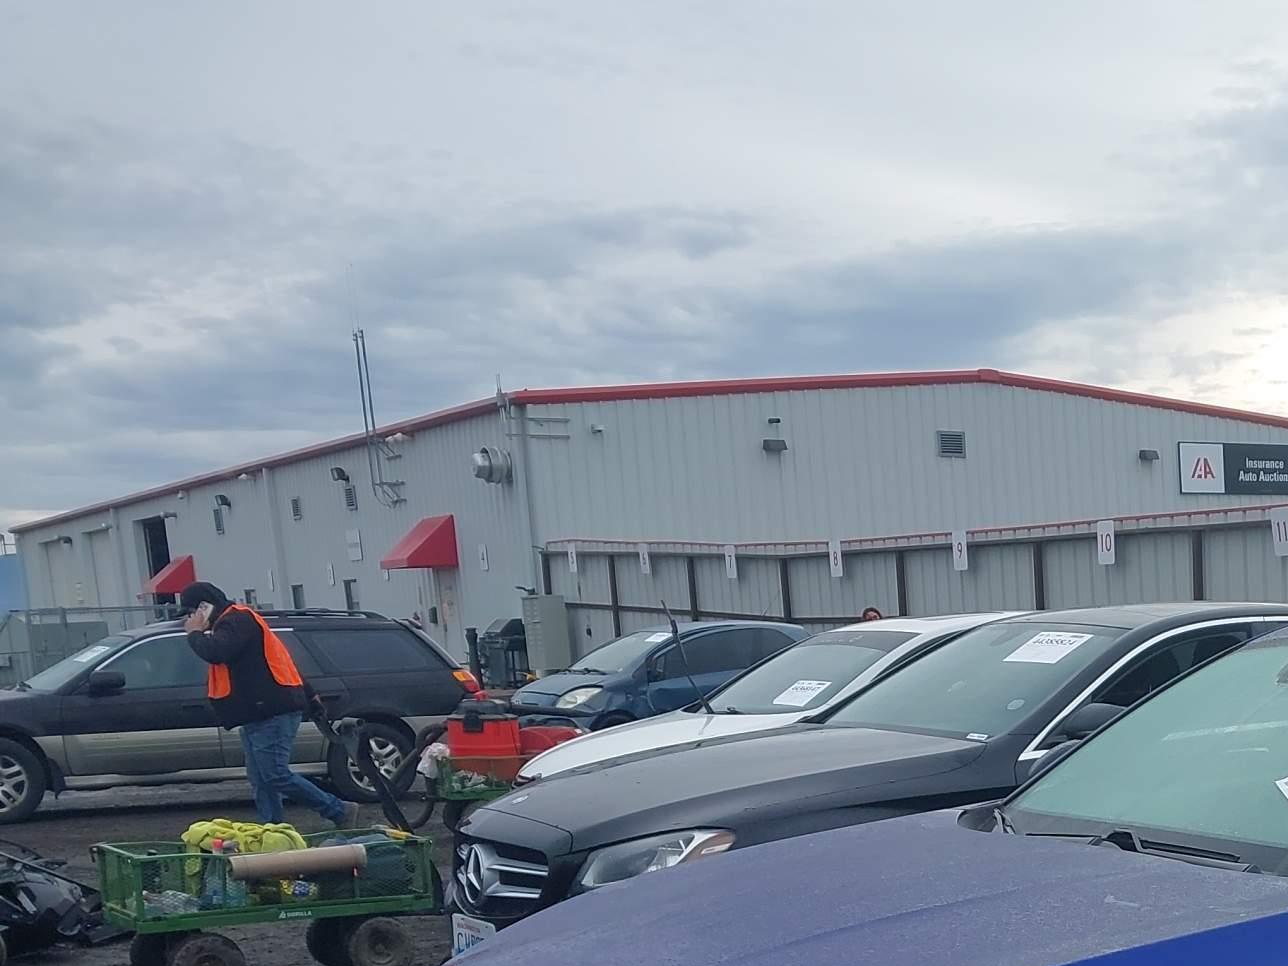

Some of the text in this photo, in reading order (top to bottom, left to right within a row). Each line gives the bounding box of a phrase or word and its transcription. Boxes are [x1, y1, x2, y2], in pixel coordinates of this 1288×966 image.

[1245, 457, 1285, 470] Insurance
[1238, 470, 1258, 482] Auto
[1274, 520, 1288, 543] 11
[957, 542, 963, 559] 9
[1100, 533, 1113, 553] 10
[727, 554, 733, 569] 7
[833, 551, 839, 567] 8
